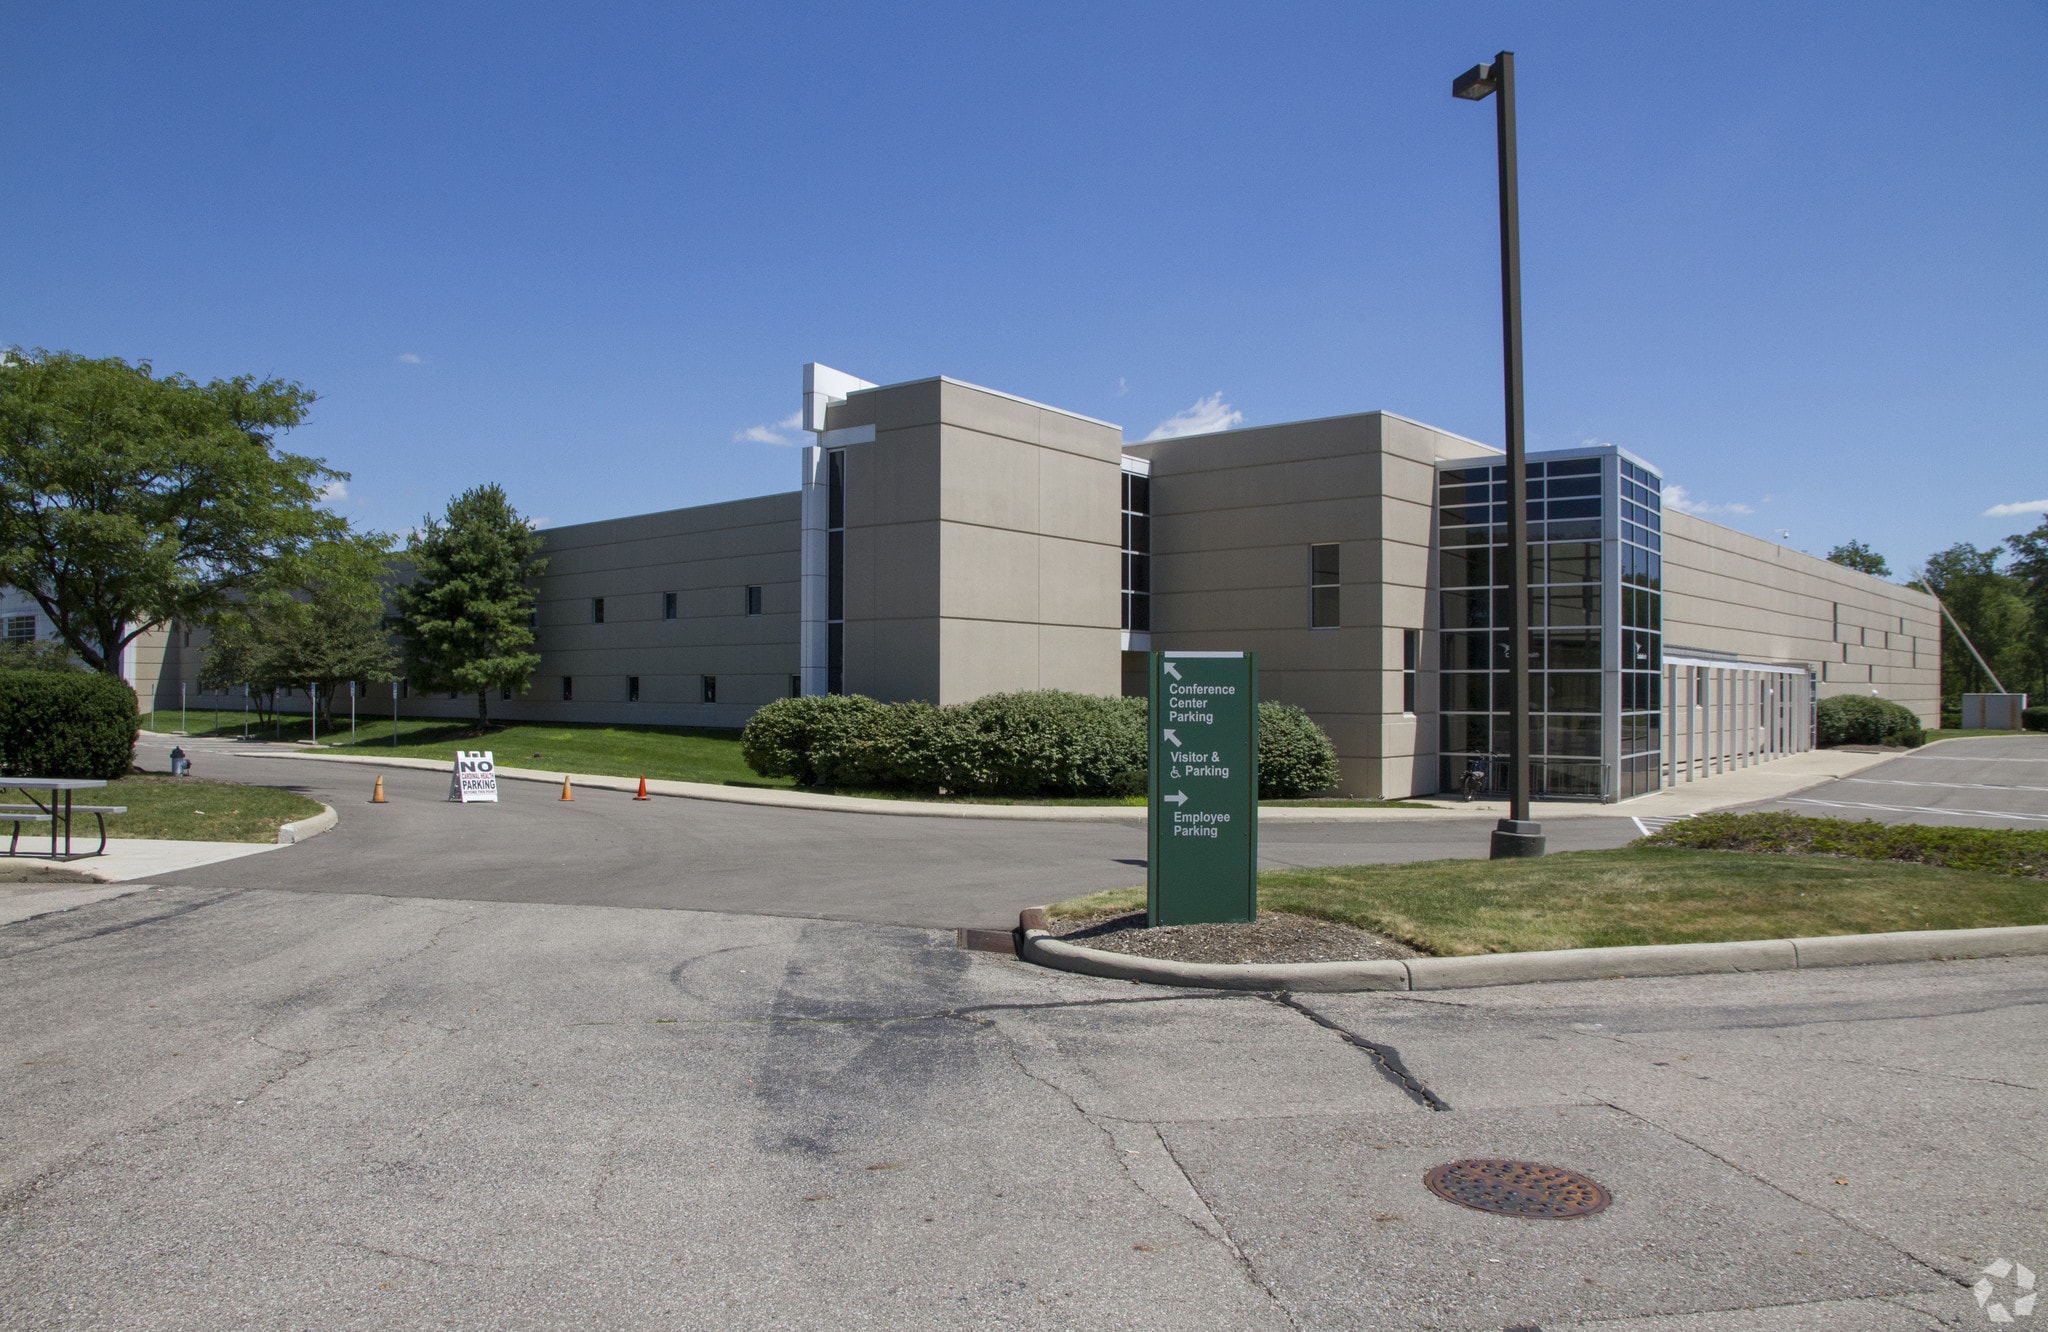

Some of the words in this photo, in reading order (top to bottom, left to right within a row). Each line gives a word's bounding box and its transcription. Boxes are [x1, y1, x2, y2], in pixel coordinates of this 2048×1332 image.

[1169, 683, 1235, 695] Conference
[1169, 697, 1208, 708] Center
[1169, 711, 1213, 724] Parking
[1170, 751, 1208, 762] Visitor
[1211, 751, 1220, 762] &
[460, 761, 493, 772] NO
[1185, 765, 1229, 778] Parking
[462, 780, 496, 790] PARKING
[1174, 811, 1230, 825] Employee
[1174, 825, 1218, 838] Parking
